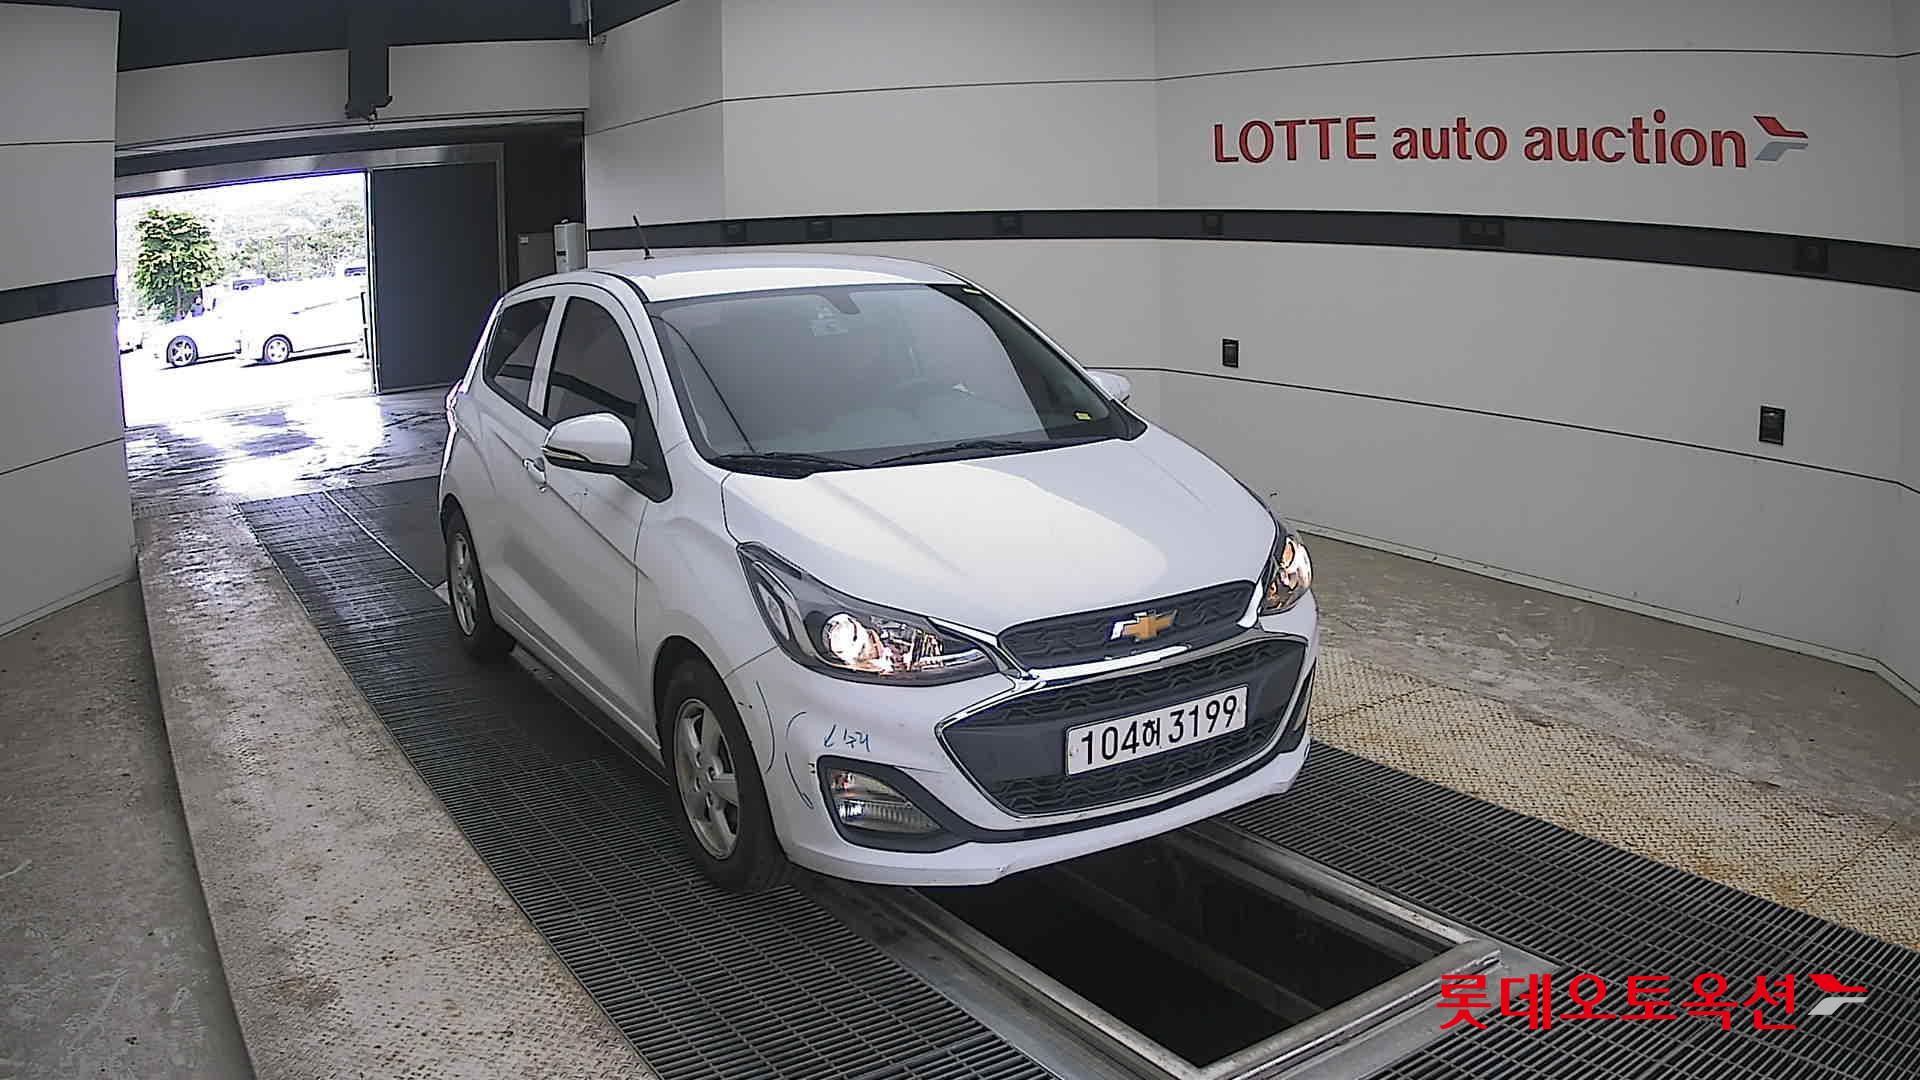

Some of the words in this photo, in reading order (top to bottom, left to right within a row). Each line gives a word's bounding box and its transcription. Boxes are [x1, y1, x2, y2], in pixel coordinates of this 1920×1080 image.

[1213, 116, 1377, 164] LOTTE
[1392, 117, 1508, 161] auto
[1523, 110, 1747, 168] auction
